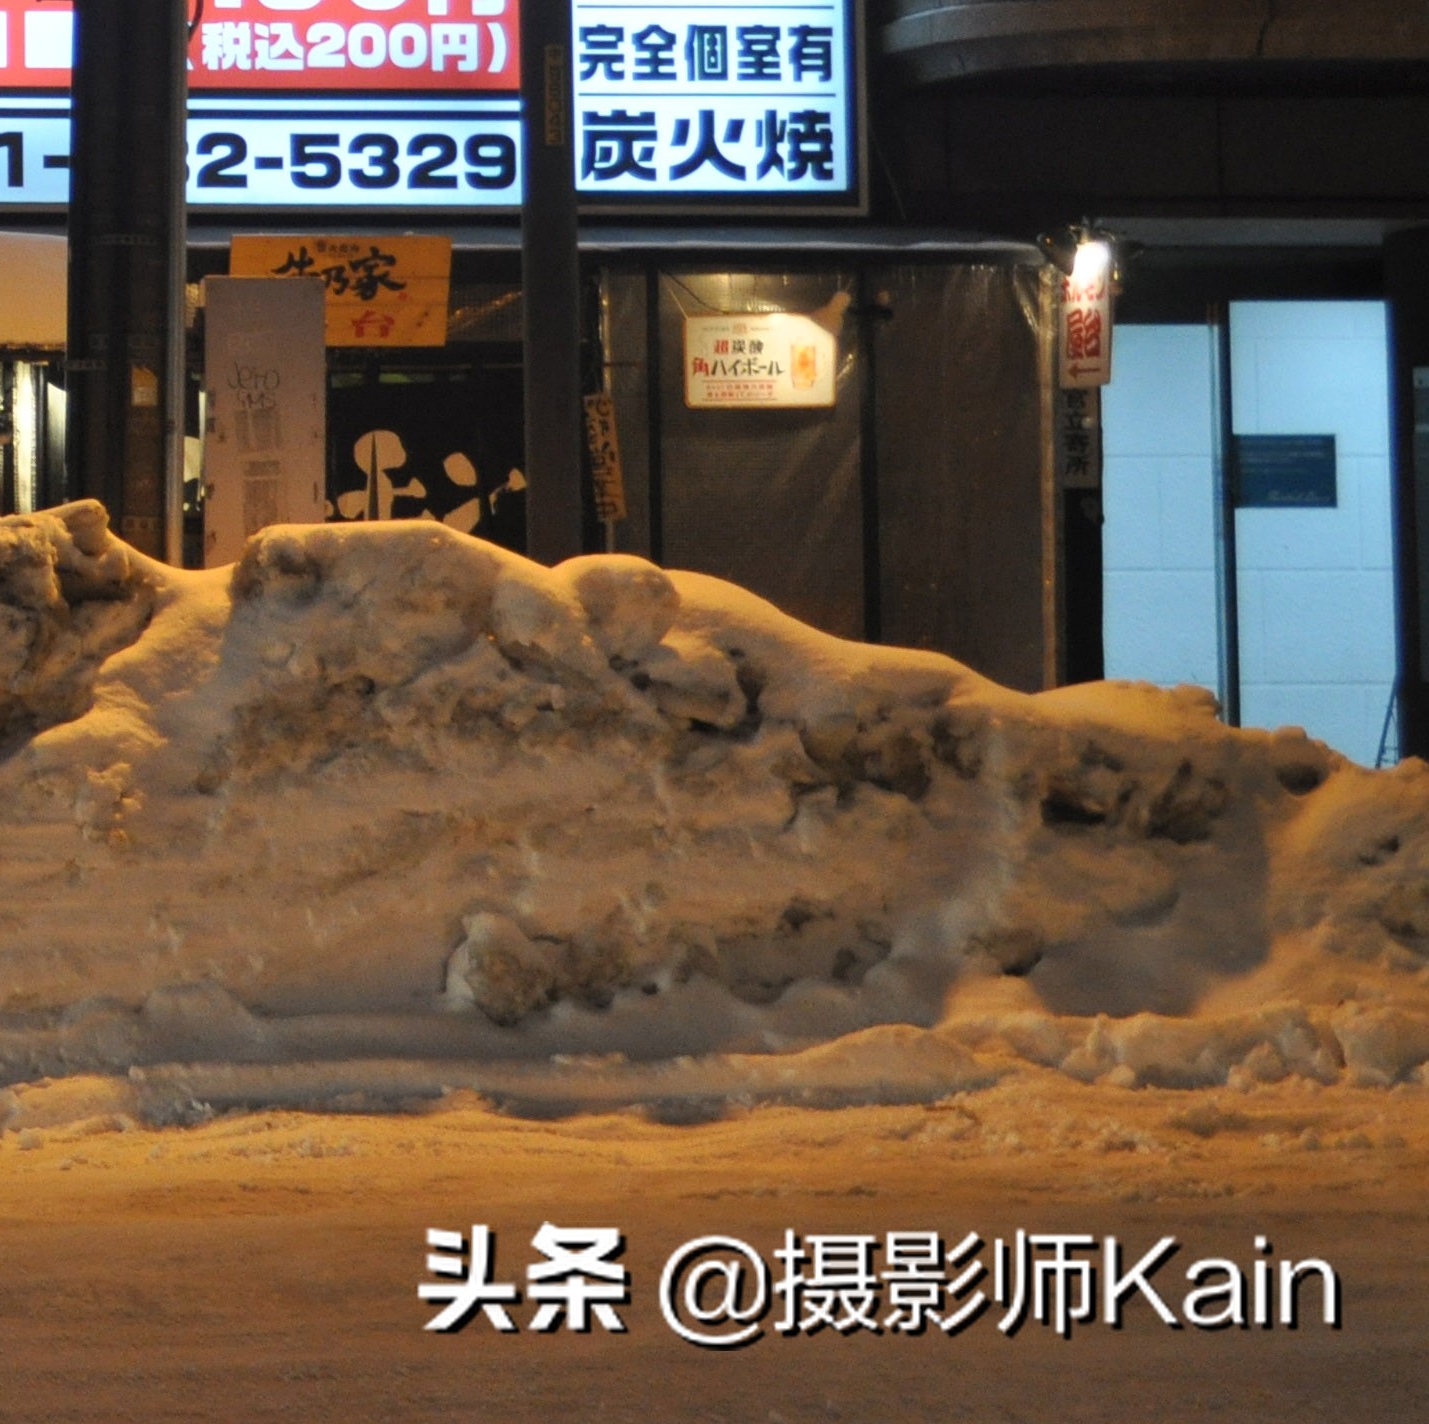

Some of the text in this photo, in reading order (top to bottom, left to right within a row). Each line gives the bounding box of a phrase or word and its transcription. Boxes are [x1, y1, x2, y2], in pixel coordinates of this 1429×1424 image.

[578, 23, 834, 83] 完全個室有
[581, 109, 834, 182] 炭火焼
[693, 357, 784, 376] 角ハイボール
